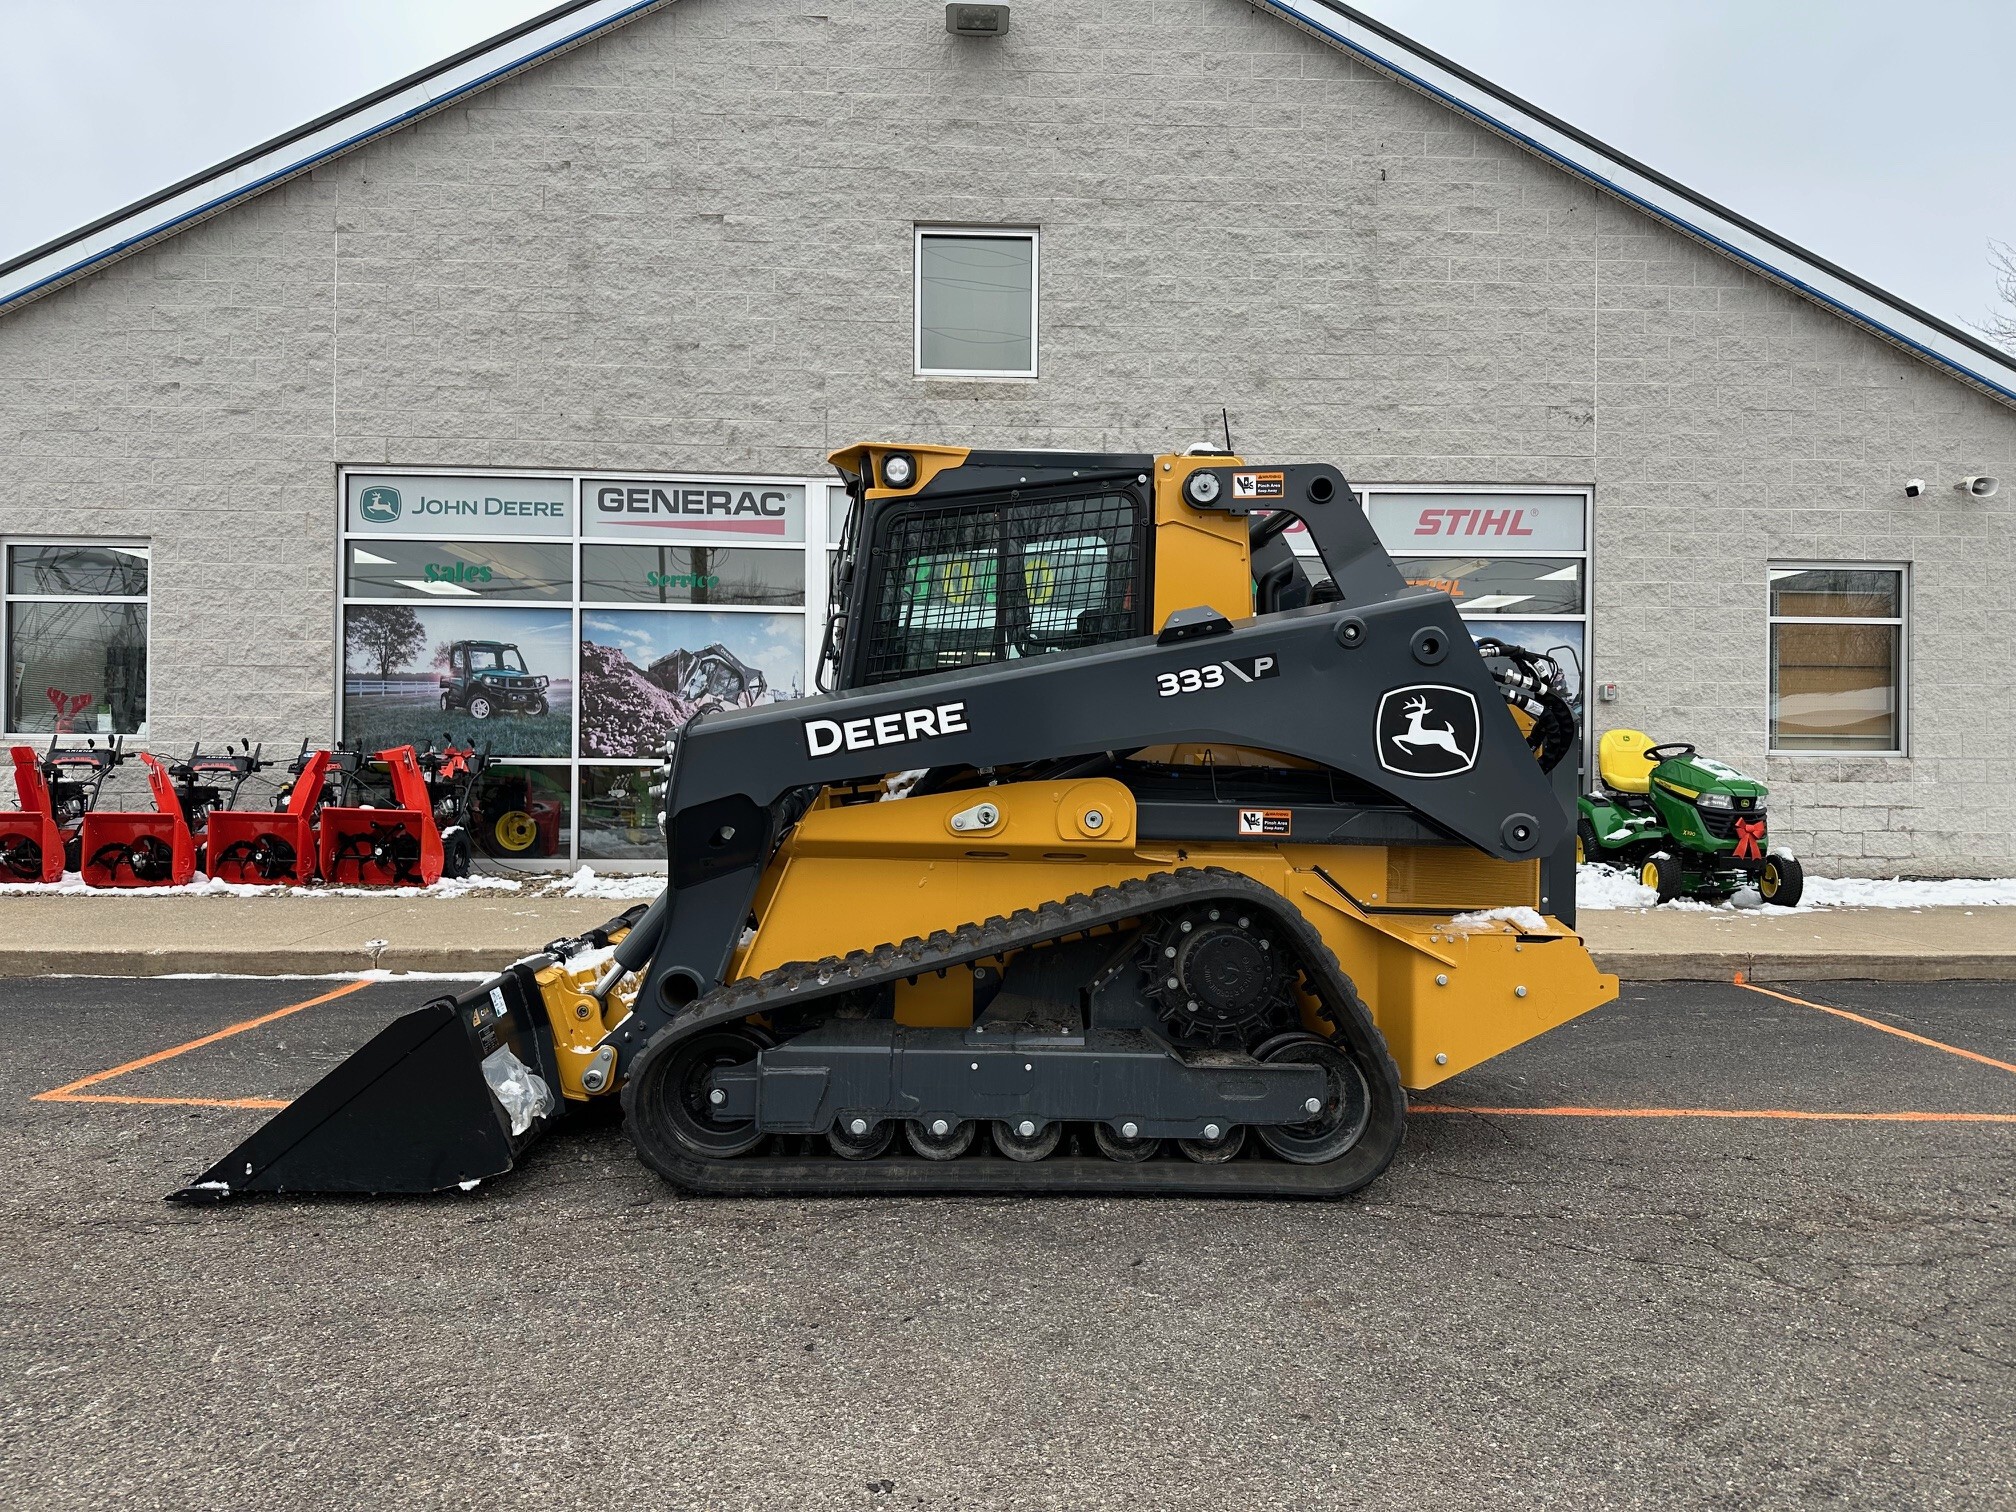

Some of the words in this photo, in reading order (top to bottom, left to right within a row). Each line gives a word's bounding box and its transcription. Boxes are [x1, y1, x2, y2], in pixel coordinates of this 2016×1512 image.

[411, 496, 478, 515] JOHN
[484, 497, 564, 517] DEERE
[423, 560, 493, 583] Sales
[646, 570, 720, 590] Service
[804, 702, 968, 757] DEERE
